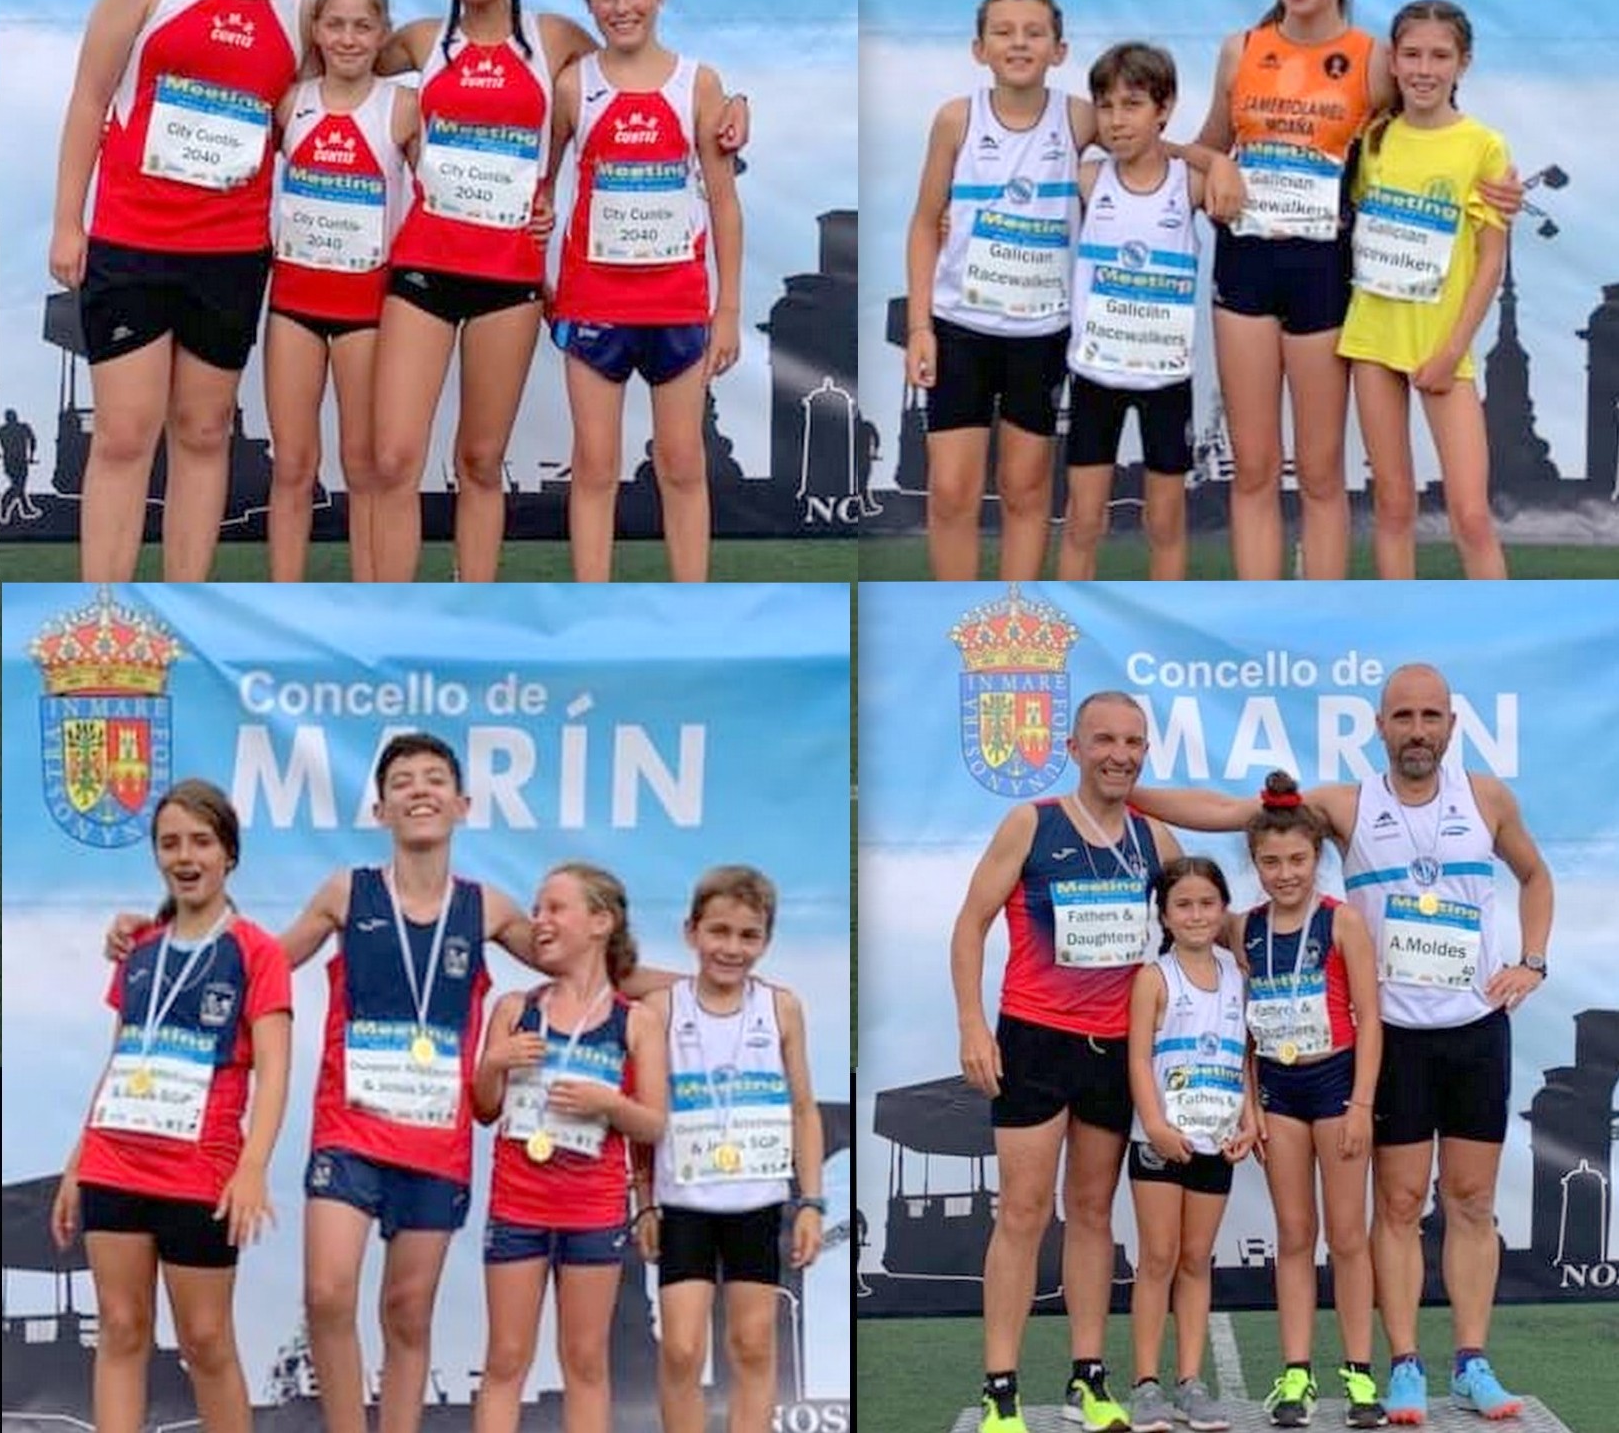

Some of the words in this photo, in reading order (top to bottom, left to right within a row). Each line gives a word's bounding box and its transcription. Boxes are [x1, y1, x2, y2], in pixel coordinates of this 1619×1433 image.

[167, 122, 193, 140] City
[182, 148, 220, 164] 2040
[455, 188, 492, 202] 2040
[308, 234, 342, 250] 2040
[620, 229, 658, 242] 2040
[990, 244, 1053, 264] Galician
[969, 265, 1064, 288] Racewalkers
[1106, 299, 1170, 319] Galician
[1085, 321, 1186, 346] Racewalkers
[1127, 649, 1318, 689] Concello
[1332, 651, 1383, 688] de
[238, 671, 467, 716] Concello
[486, 673, 547, 716] de
[1139, 692, 1520, 780] MARN
[1056, 881, 1142, 894] Meeting
[1068, 909, 1119, 923] Fathers
[1122, 910, 1133, 922] &
[1067, 933, 1136, 948] Daughters
[1389, 935, 1466, 960] A.Moldes
